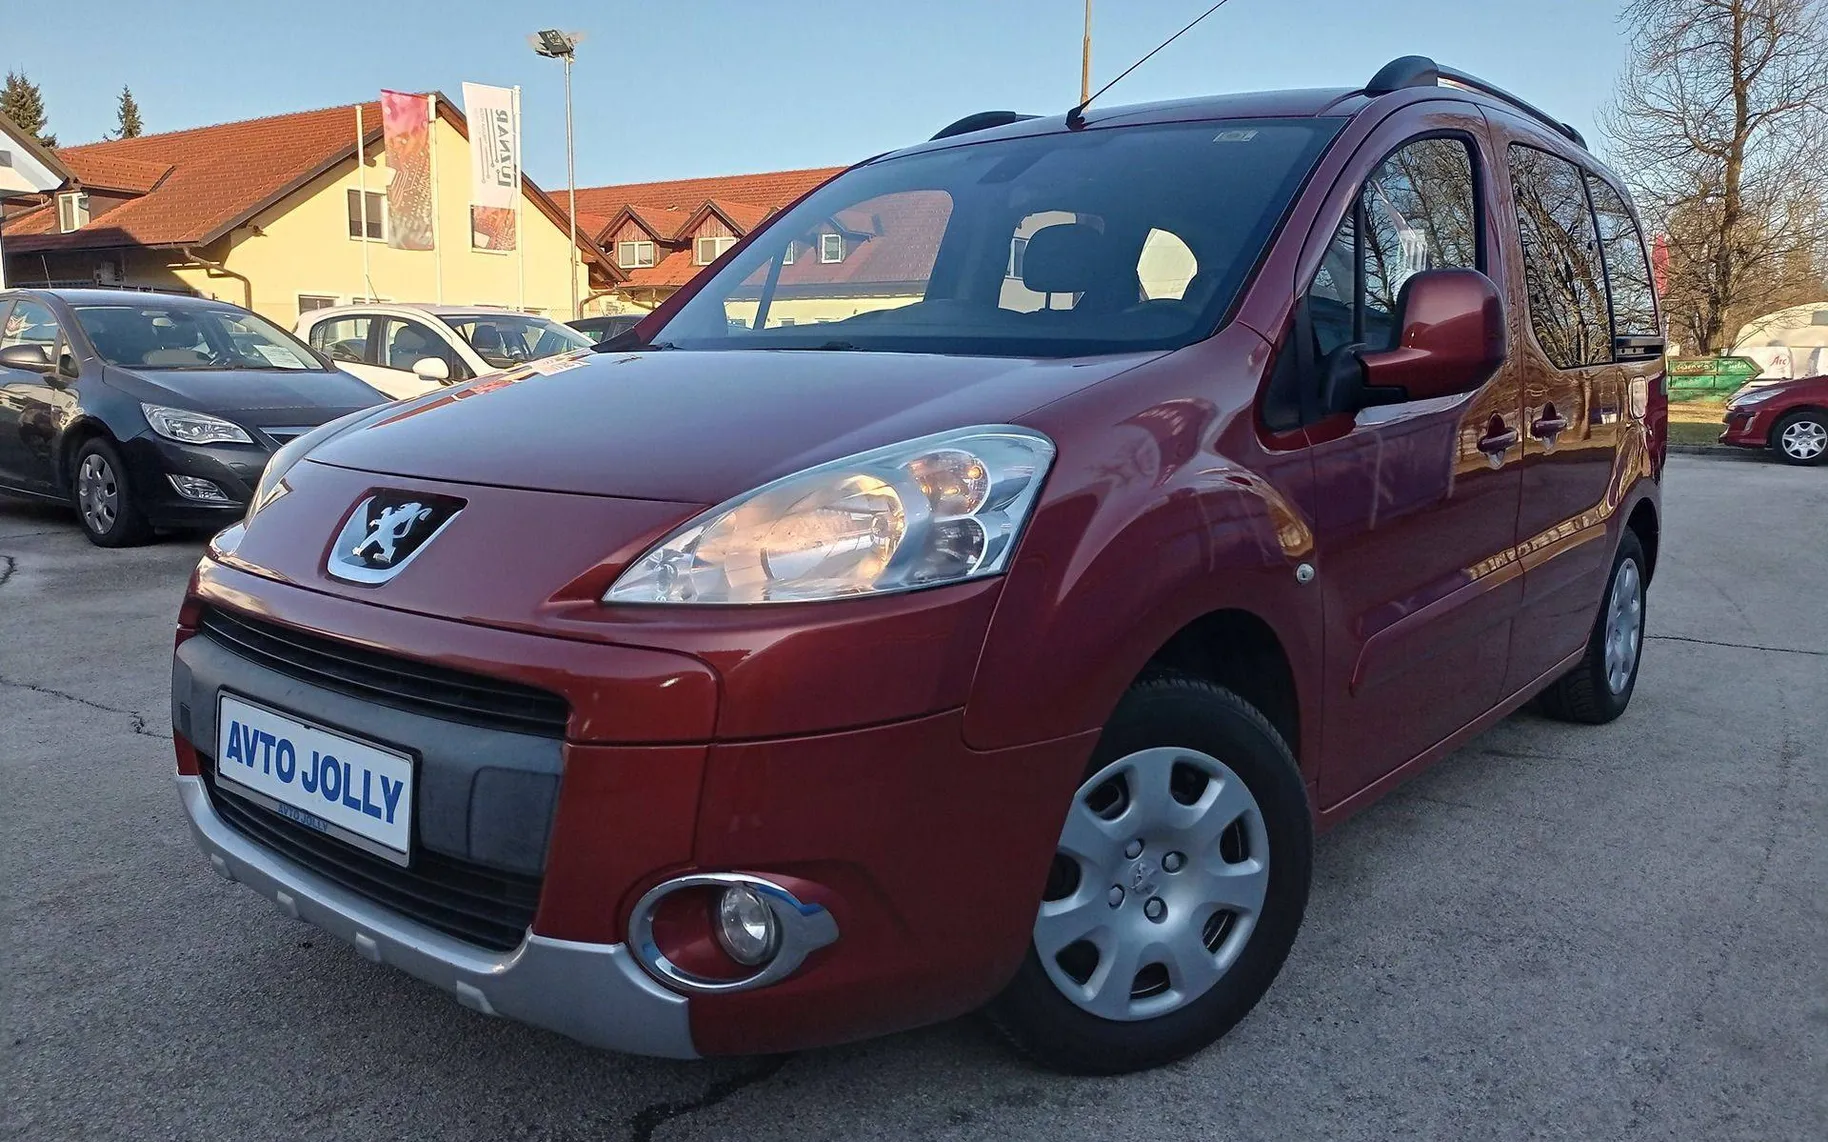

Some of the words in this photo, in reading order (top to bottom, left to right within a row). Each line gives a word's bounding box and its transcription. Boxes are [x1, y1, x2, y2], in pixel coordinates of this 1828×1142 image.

[226, 720, 296, 784] AVTO
[301, 750, 404, 825] JOLLY
[277, 803, 300, 820] AVTO
[301, 813, 328, 832] JOLLY
